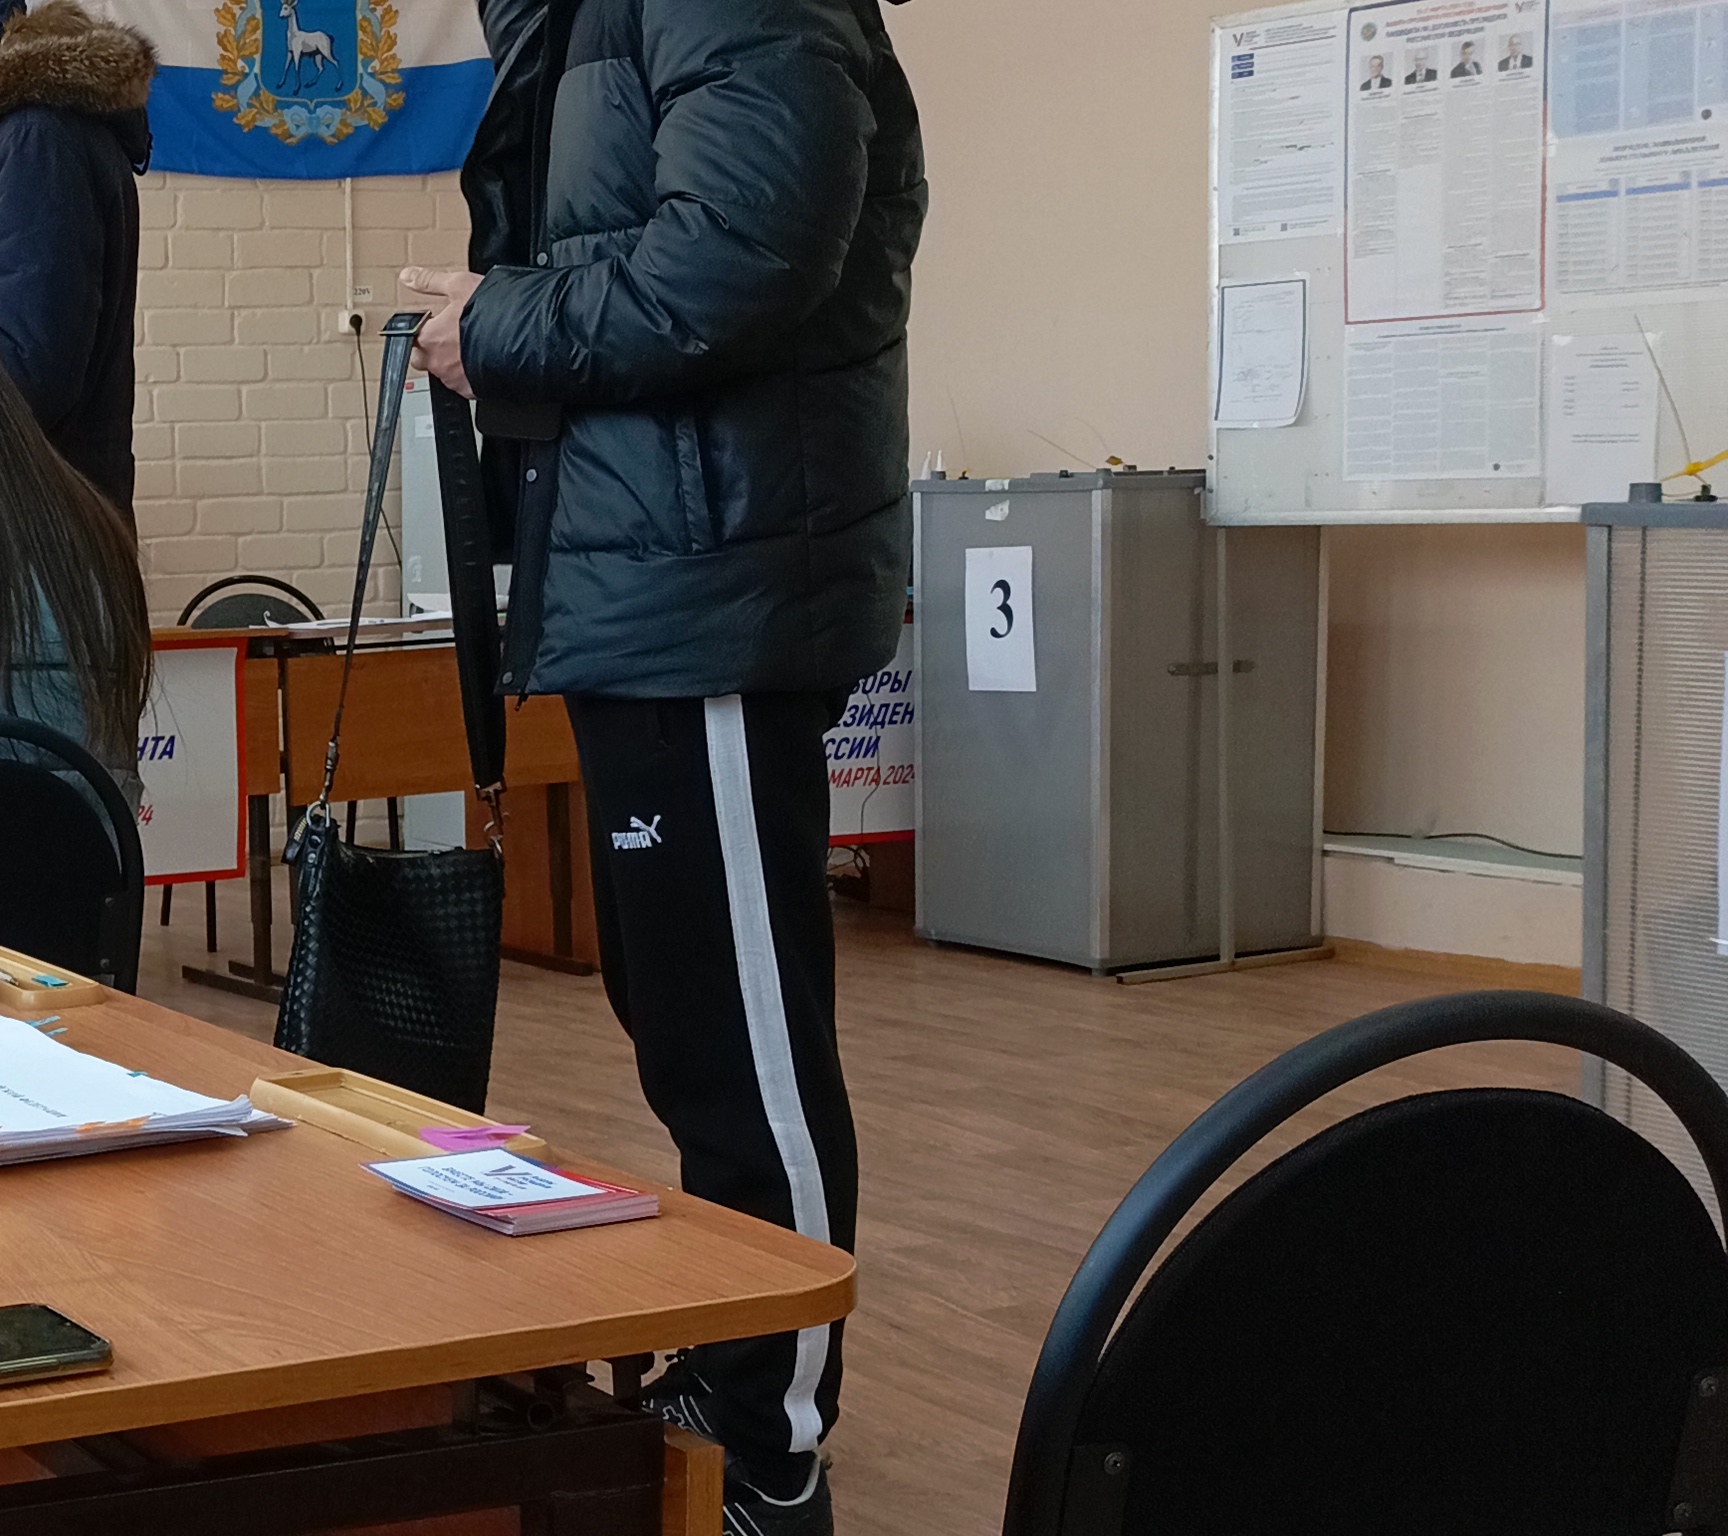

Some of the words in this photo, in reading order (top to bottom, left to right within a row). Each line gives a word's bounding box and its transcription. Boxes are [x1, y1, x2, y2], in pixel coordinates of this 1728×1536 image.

[990, 579, 1014, 639] 3
[837, 702, 915, 729] ЗИДЕН
[829, 766, 880, 788] МАРТА
[612, 831, 652, 850] PUMA
